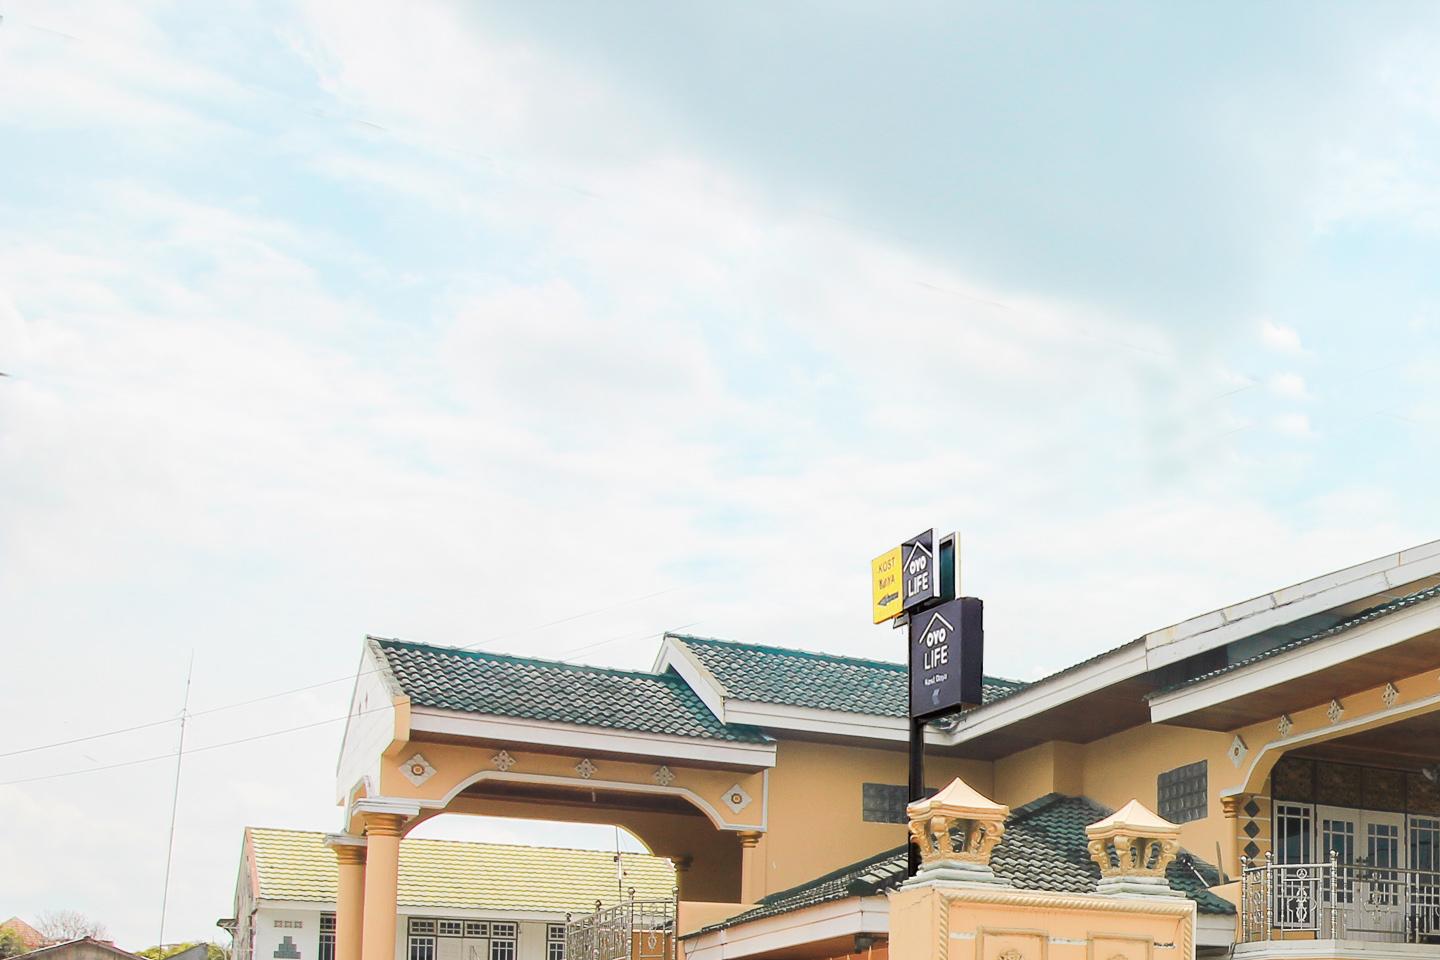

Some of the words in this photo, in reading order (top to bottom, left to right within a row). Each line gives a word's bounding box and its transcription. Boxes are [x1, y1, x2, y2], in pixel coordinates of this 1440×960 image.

[879, 557, 895, 572] KOST
[910, 556, 927, 574] OYO
[908, 572, 928, 597] LIFE
[926, 628, 946, 647] OYO
[924, 645, 948, 670] LIFE
